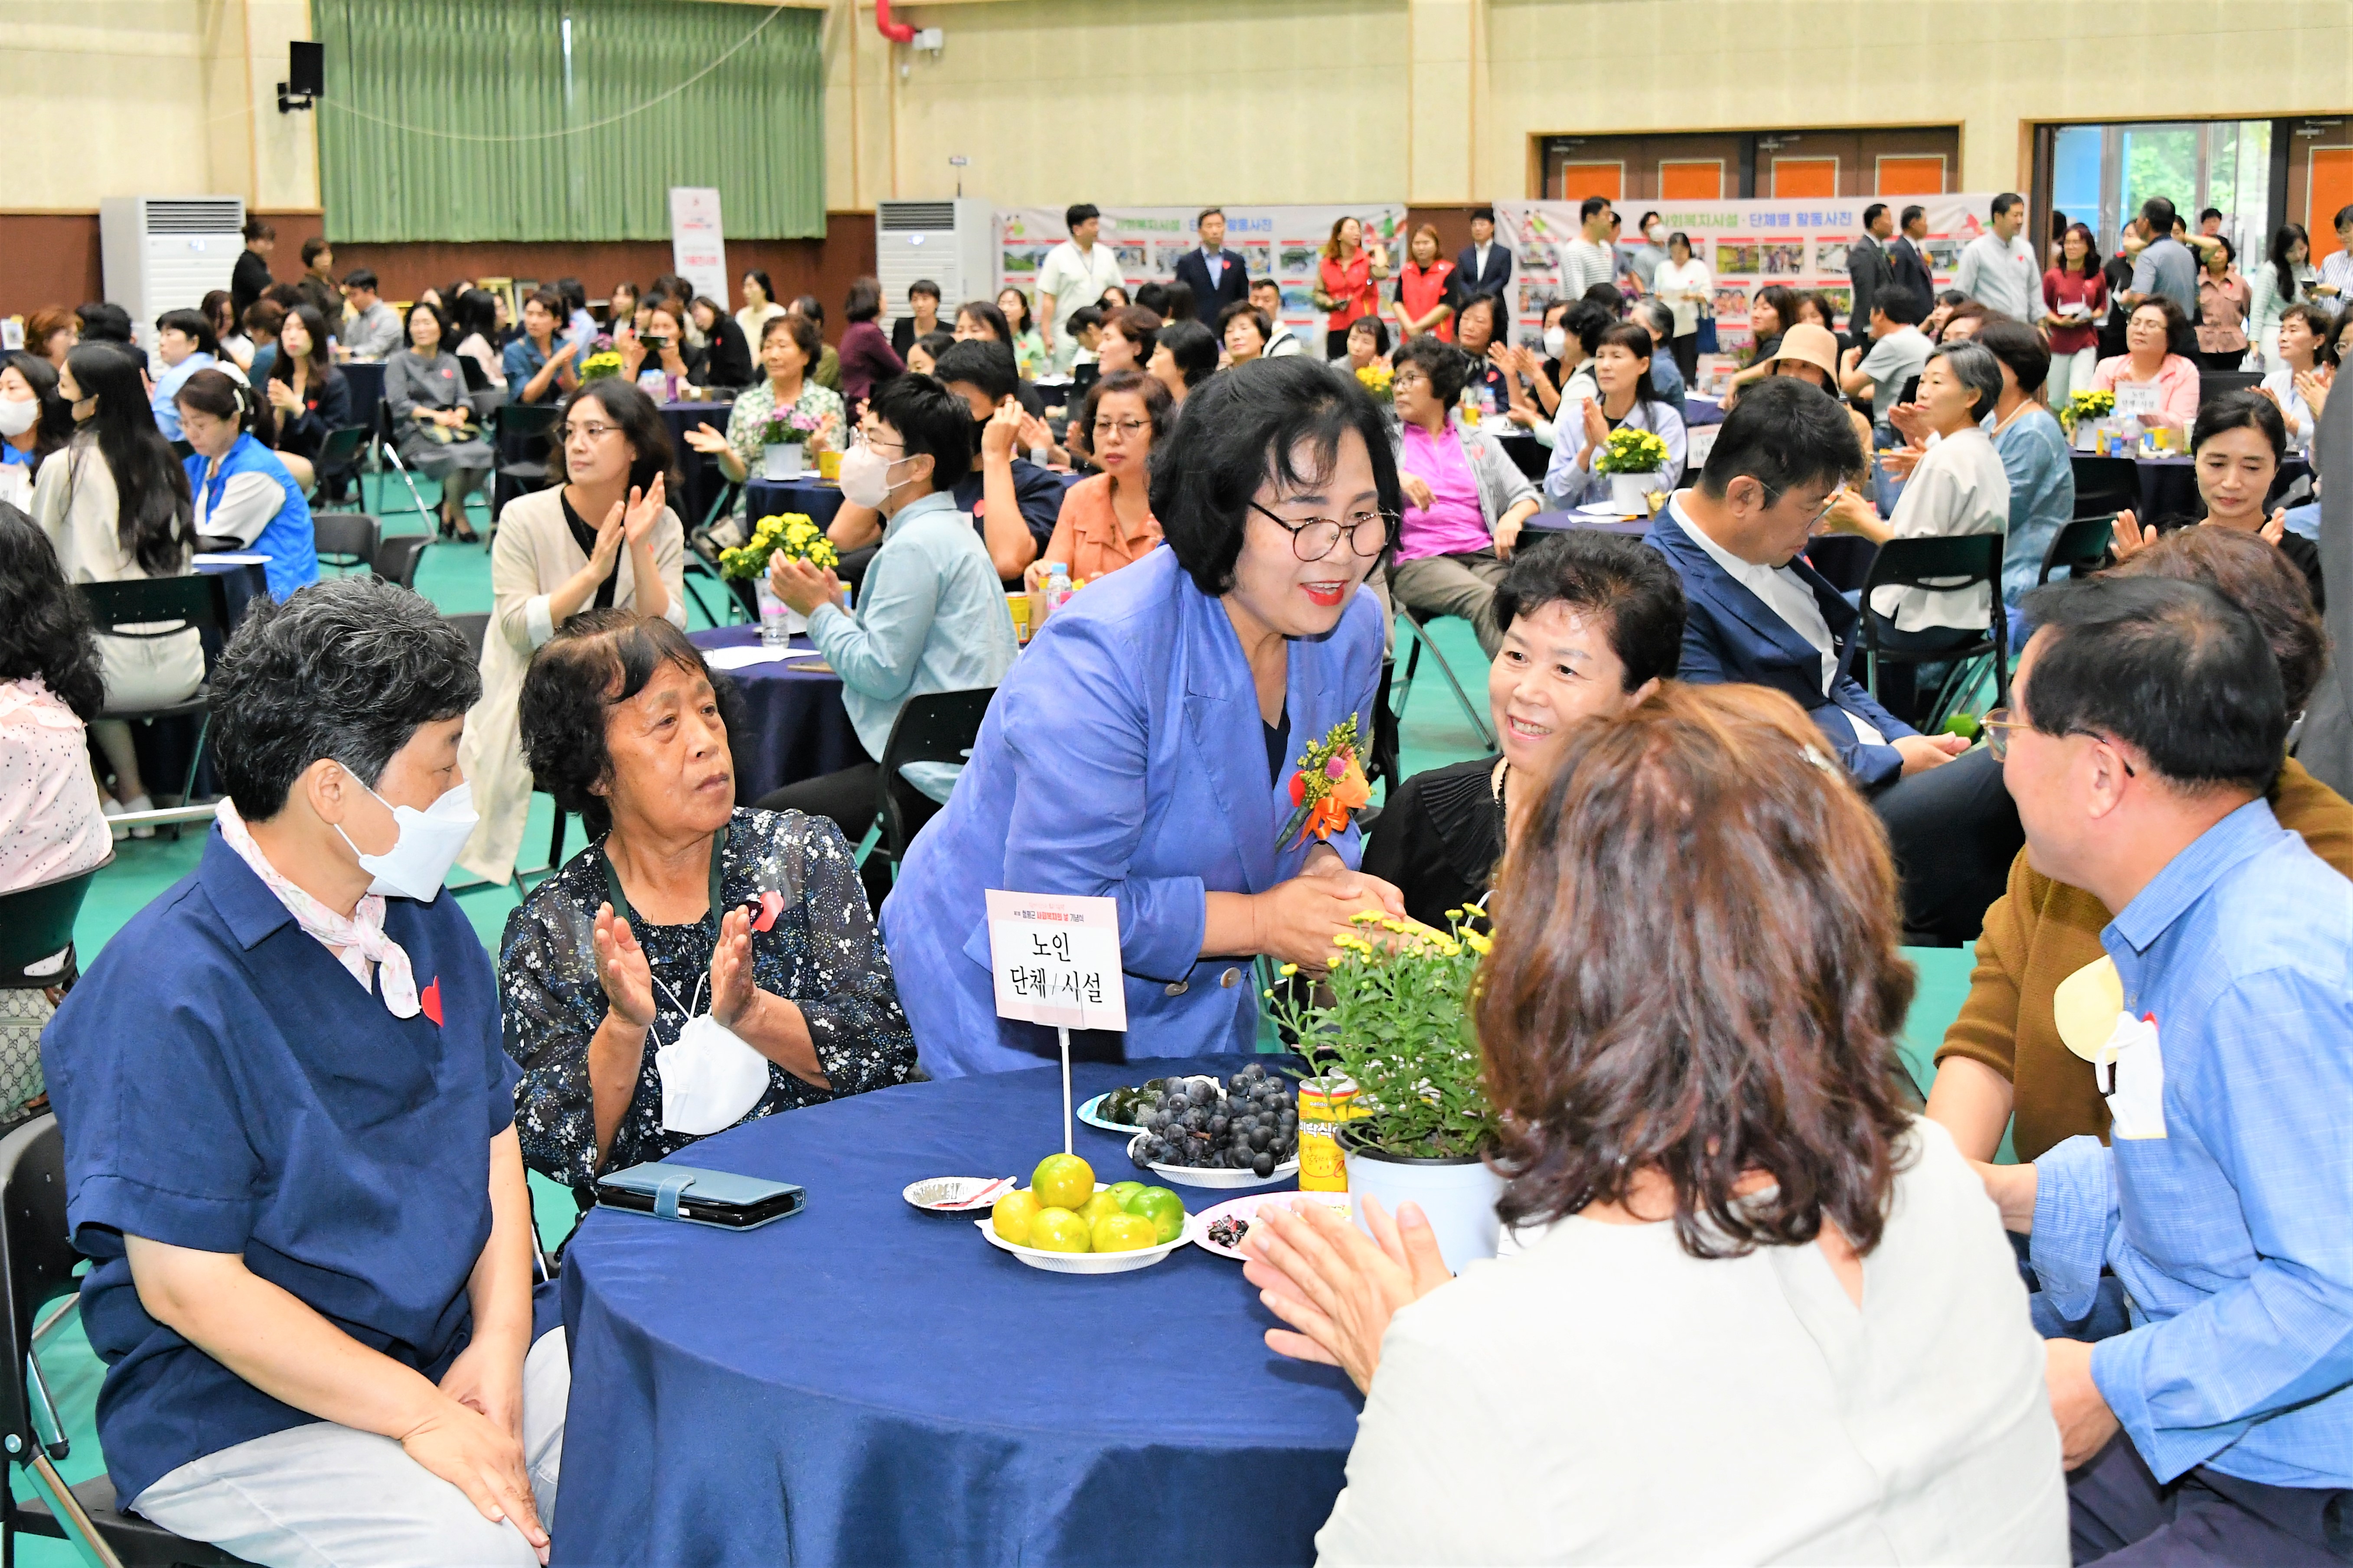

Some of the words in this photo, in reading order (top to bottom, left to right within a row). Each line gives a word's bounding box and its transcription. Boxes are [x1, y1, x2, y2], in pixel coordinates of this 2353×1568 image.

[1749, 212, 1790, 228] 단체별
[1796, 211, 1852, 227] 활동사진
[1022, 910, 1035, 919] 함평군
[1037, 911, 1062, 921] 사회복지의
[1064, 913, 1068, 922] 날
[1070, 913, 1084, 922] 기념식
[1032, 932, 1071, 962] 노인
[1010, 965, 1103, 1003] 단체/시설
